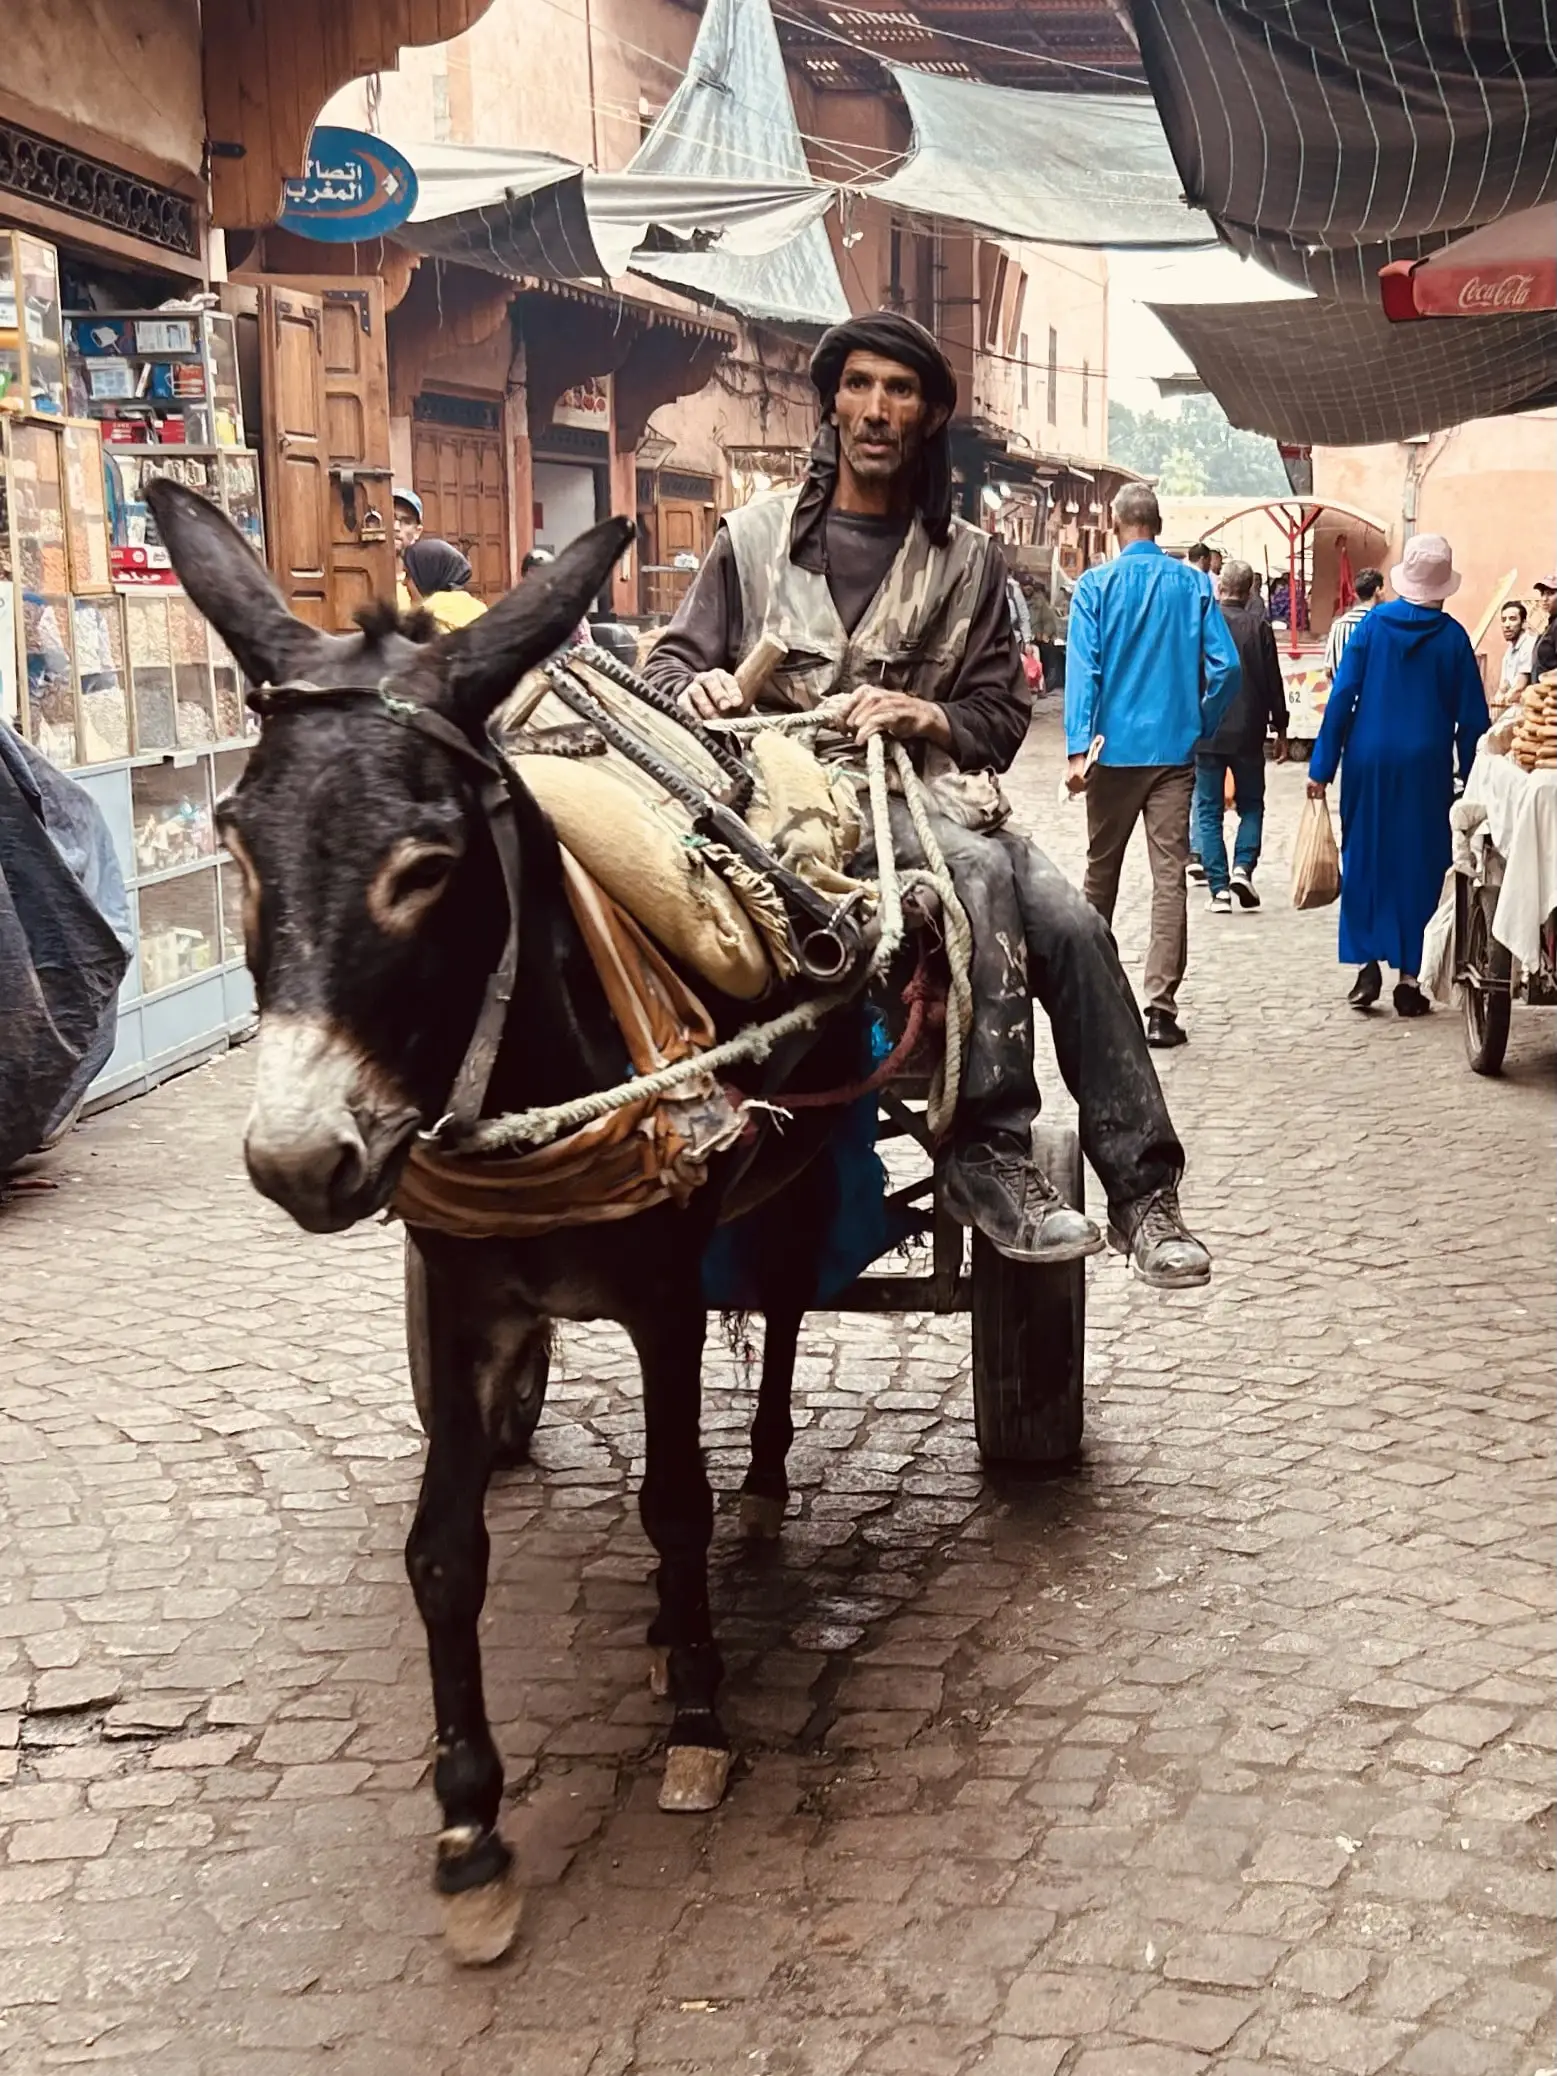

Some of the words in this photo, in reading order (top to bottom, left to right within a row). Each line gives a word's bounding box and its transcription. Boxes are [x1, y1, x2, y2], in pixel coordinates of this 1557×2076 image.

[305, 160, 362, 180] اتصا
[286, 180, 363, 203] المغرب
[1288, 691, 1301, 703] 62
